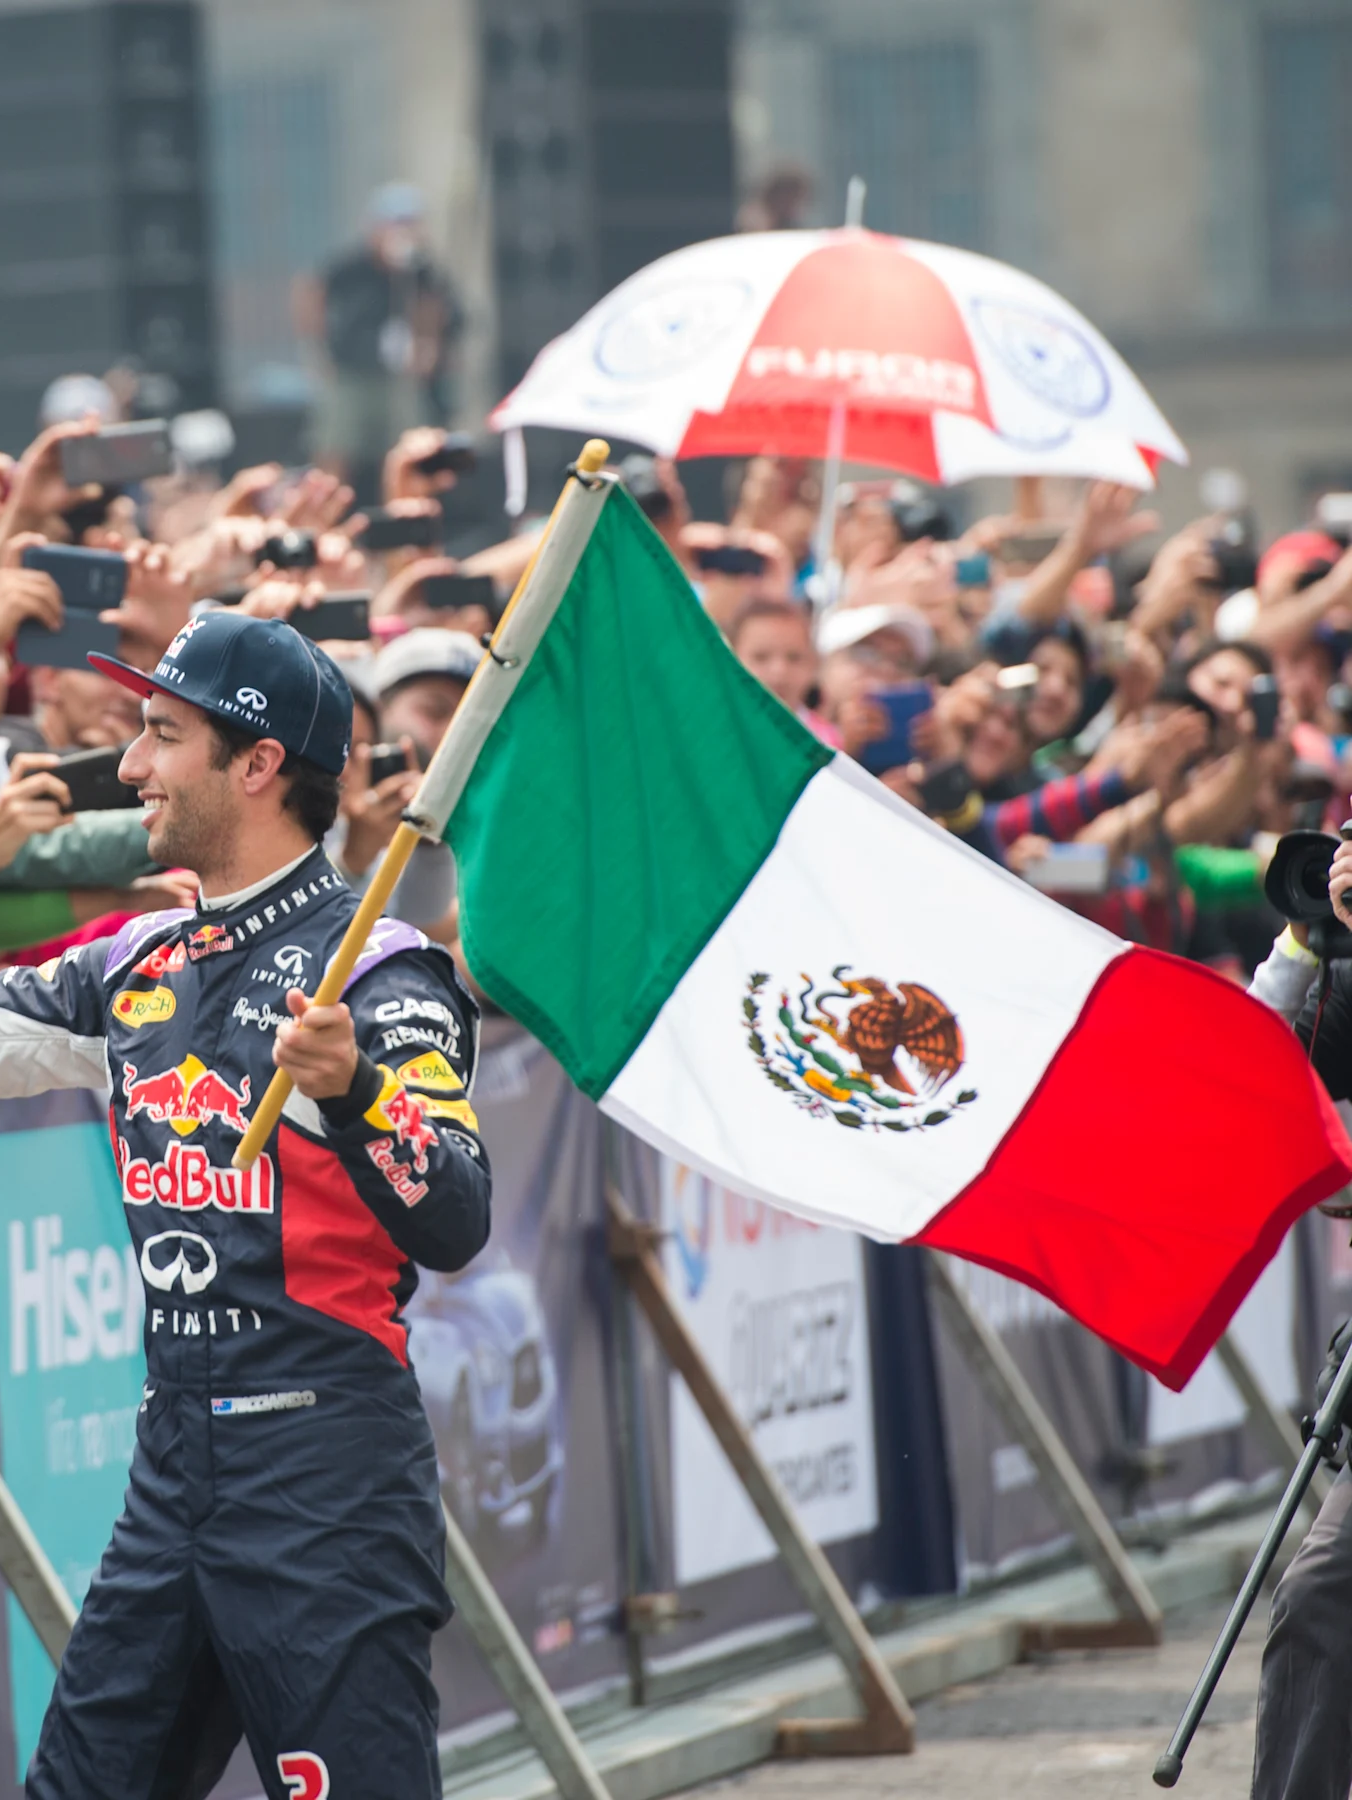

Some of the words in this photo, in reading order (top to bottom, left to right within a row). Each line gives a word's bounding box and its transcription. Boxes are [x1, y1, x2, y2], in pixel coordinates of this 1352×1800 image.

[218, 698, 271, 730] INFINITI
[235, 872, 343, 942] INFINITI
[381, 1026, 461, 1059] RENAUL
